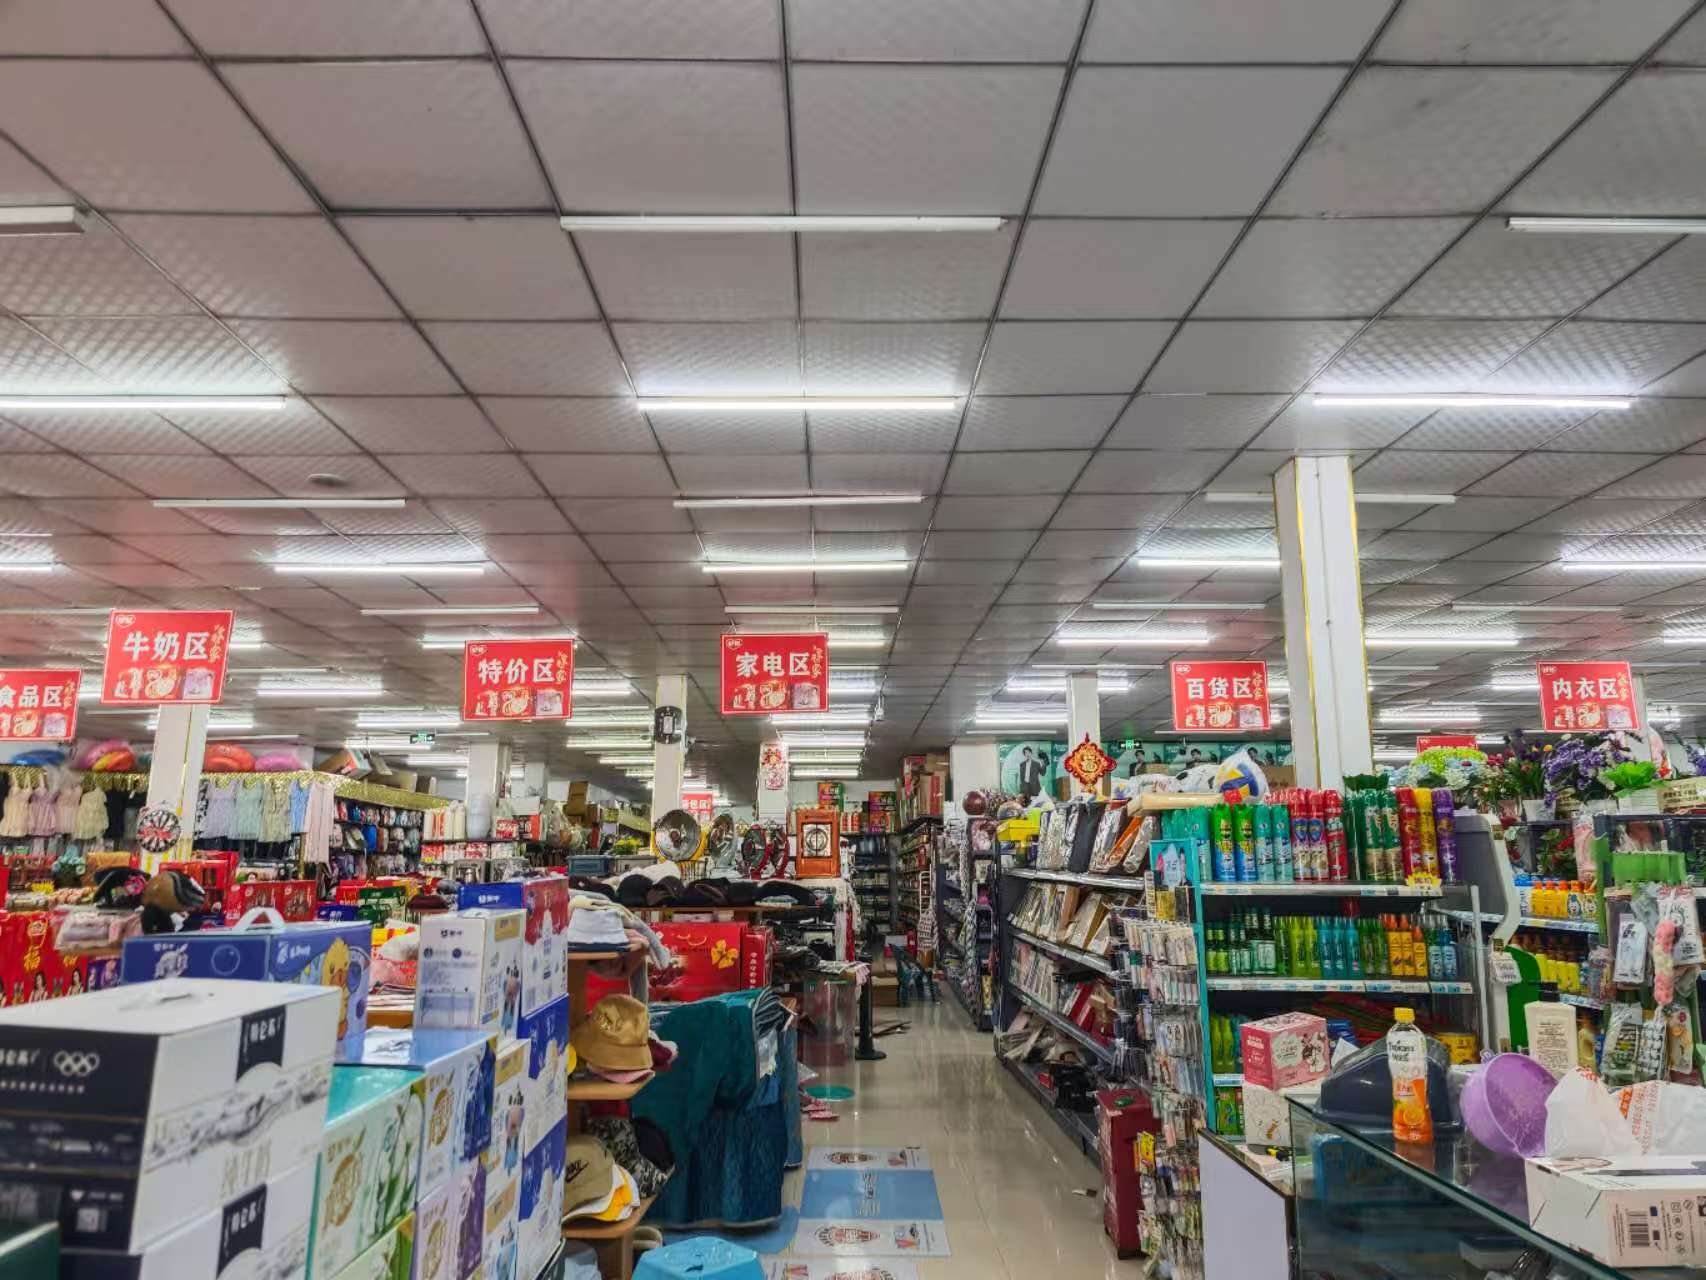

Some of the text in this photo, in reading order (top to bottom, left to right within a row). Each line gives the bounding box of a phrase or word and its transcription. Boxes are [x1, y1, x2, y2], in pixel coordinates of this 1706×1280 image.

[122, 631, 209, 661] 牛奶区
[478, 658, 555, 685] 特价区
[736, 652, 811, 677] 家电区
[0, 684, 64, 708] 食品区
[1186, 677, 1252, 700] 百货区
[1552, 678, 1619, 700] 内衣区
